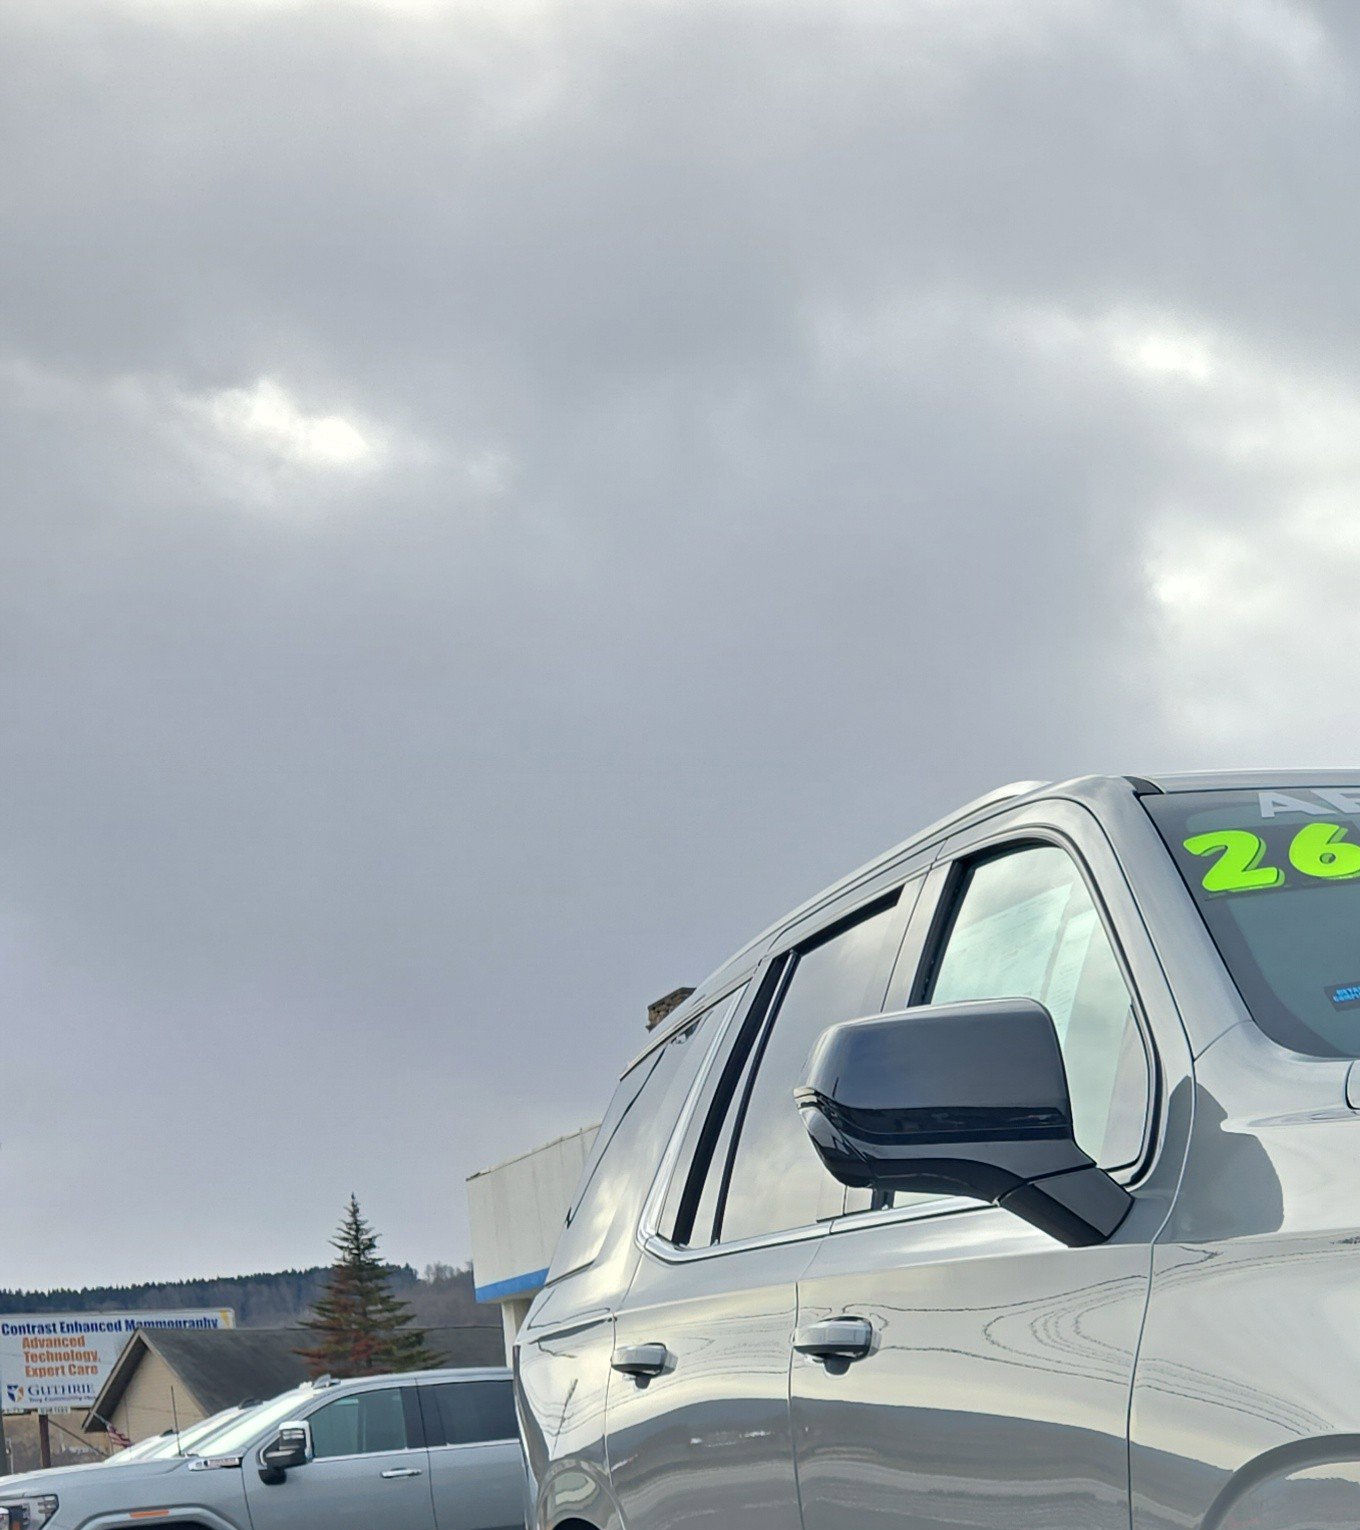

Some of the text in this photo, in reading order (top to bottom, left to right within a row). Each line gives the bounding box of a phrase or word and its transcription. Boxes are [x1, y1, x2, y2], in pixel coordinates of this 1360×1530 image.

[1, 1323, 58, 1336] Contrast
[59, 1320, 122, 1334] Enhanced
[22, 1335, 86, 1349] Advanced
[25, 1364, 99, 1378] Expert Care
